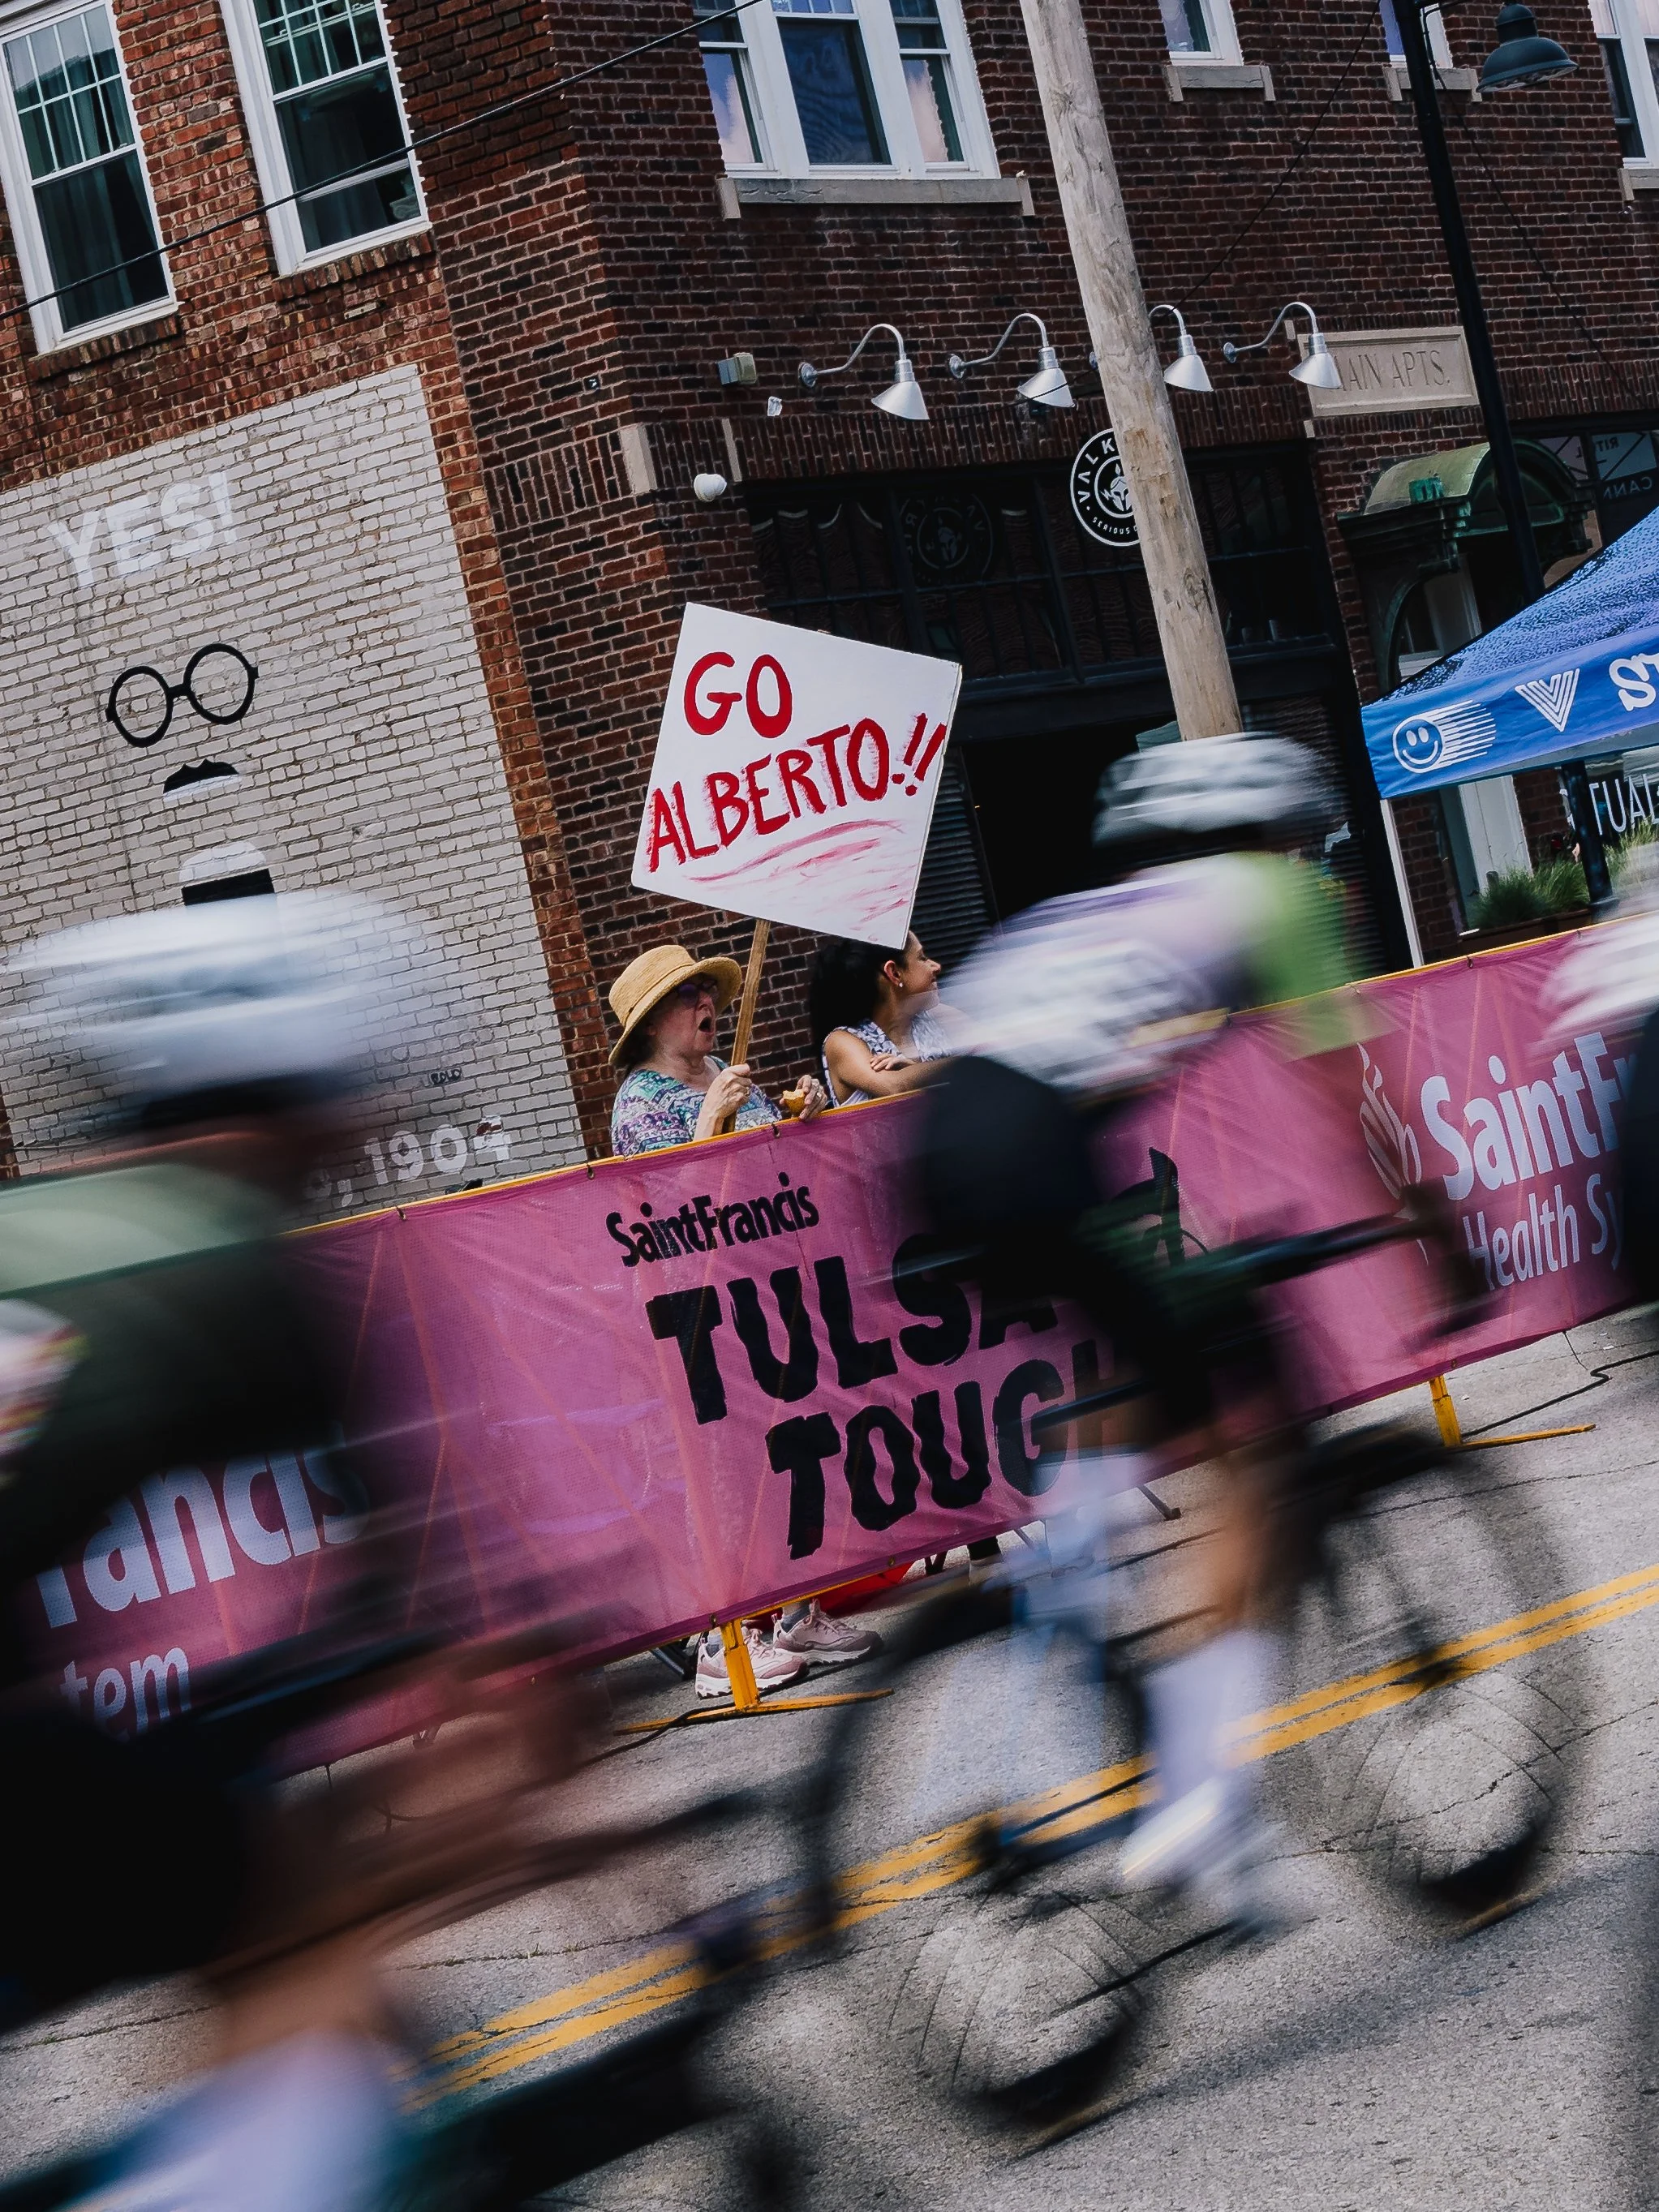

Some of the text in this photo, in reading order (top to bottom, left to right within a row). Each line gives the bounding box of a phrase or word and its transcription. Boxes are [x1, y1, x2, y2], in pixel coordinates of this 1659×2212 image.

[1391, 350, 1451, 389] APTS.
[46, 471, 237, 588] YES!
[1092, 516, 1130, 535] SERIOUS
[683, 651, 793, 739] GO
[647, 712, 948, 873] ALBERTO!!
[364, 1115, 511, 1185] 1904
[606, 1171, 820, 1267] SaintFrancis
[1462, 1184, 1581, 1291] Health
